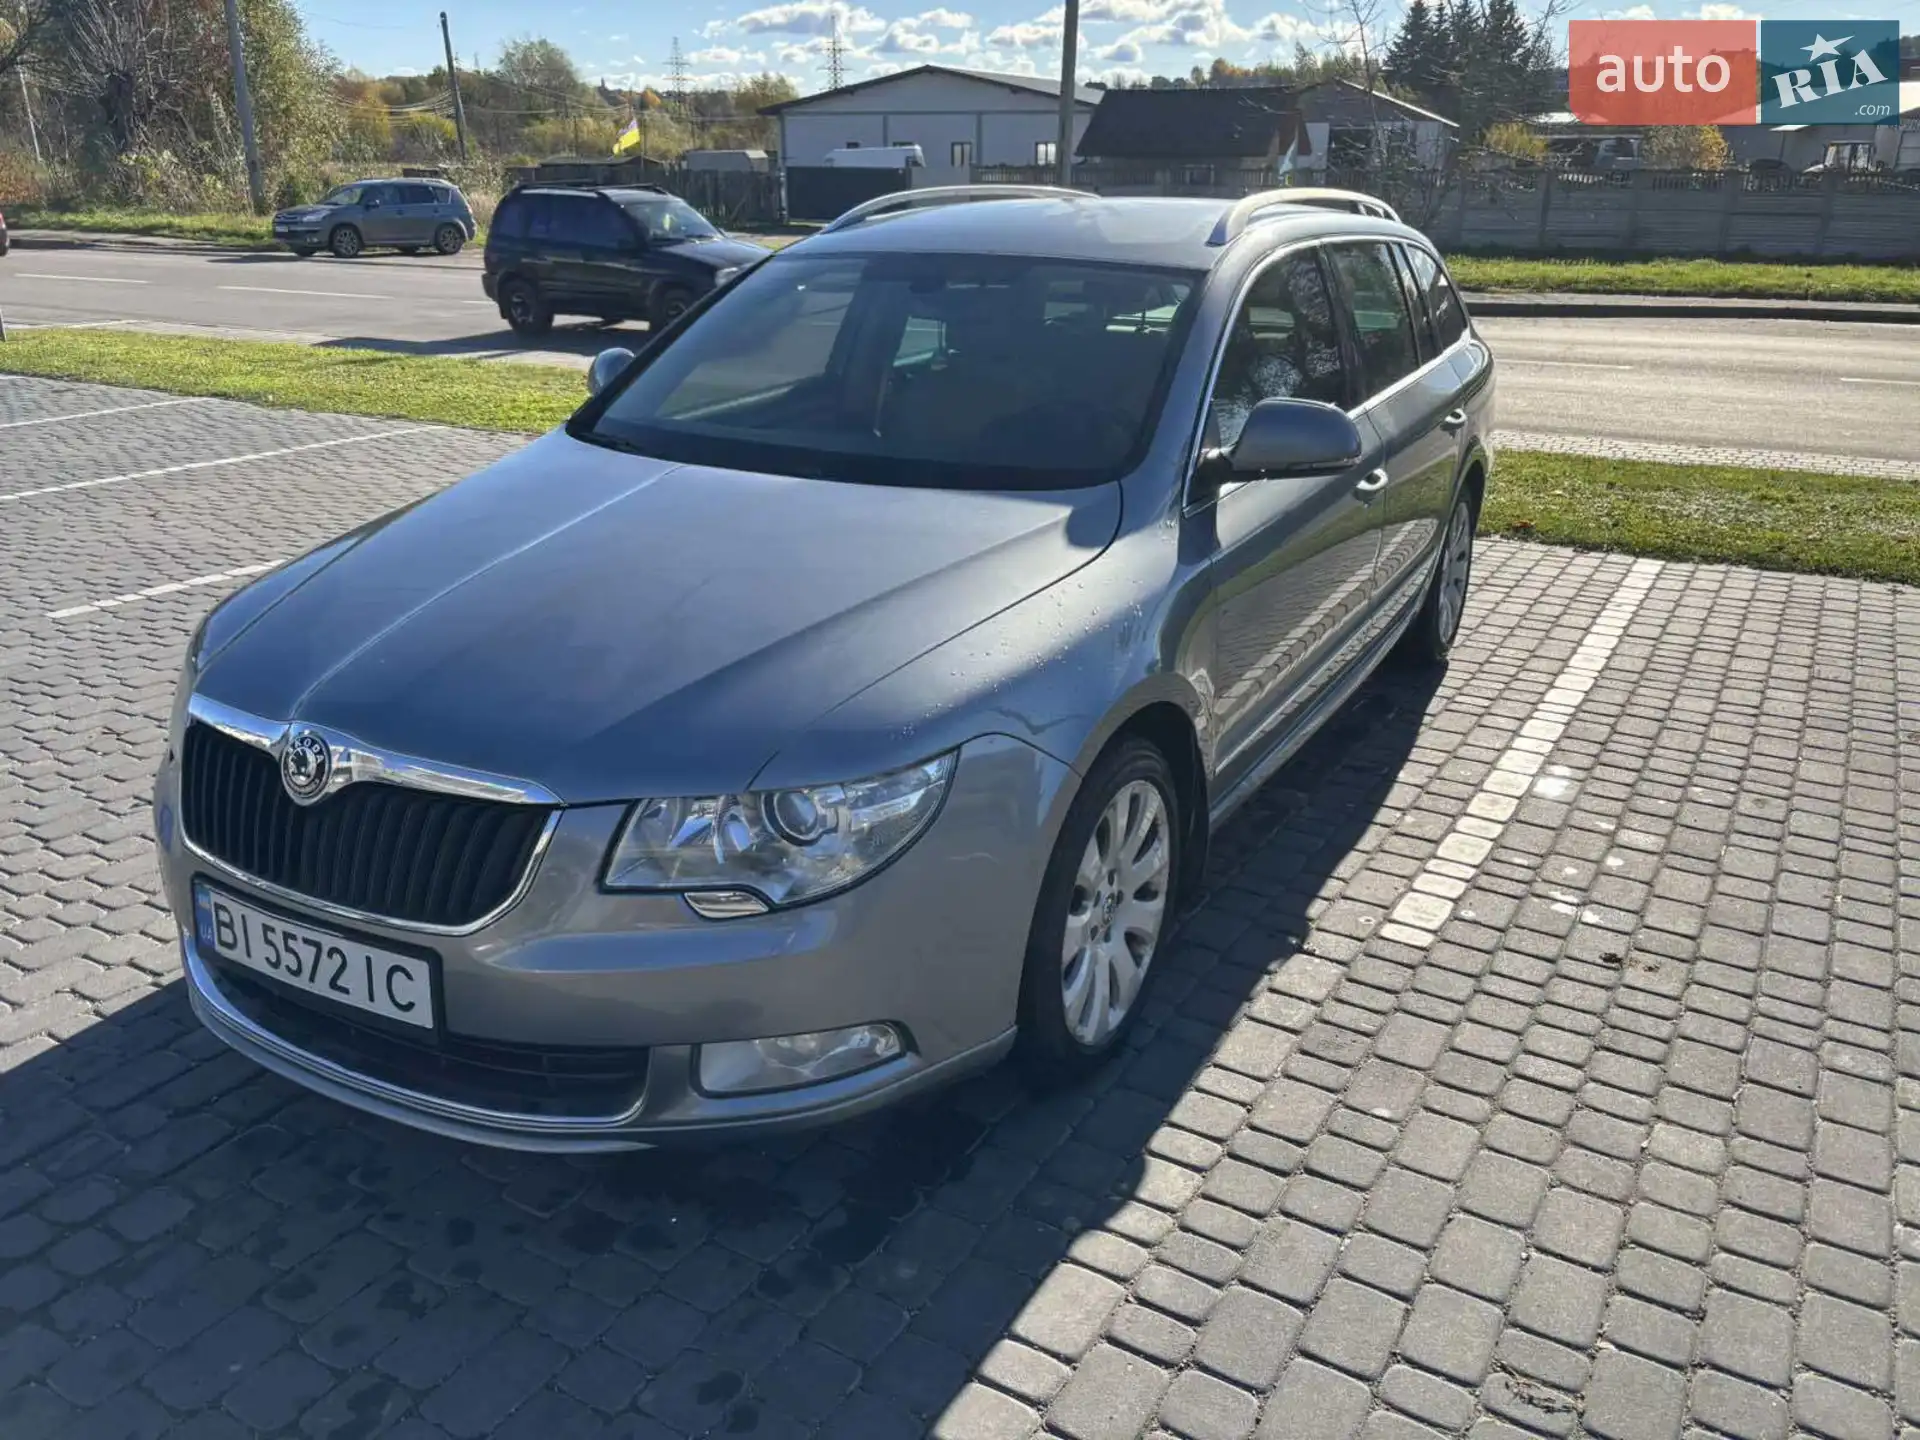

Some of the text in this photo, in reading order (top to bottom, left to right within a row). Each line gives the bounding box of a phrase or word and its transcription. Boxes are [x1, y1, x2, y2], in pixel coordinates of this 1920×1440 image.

[200, 923, 213, 942] UA
[213, 901, 416, 1013] BI 5572 IC
